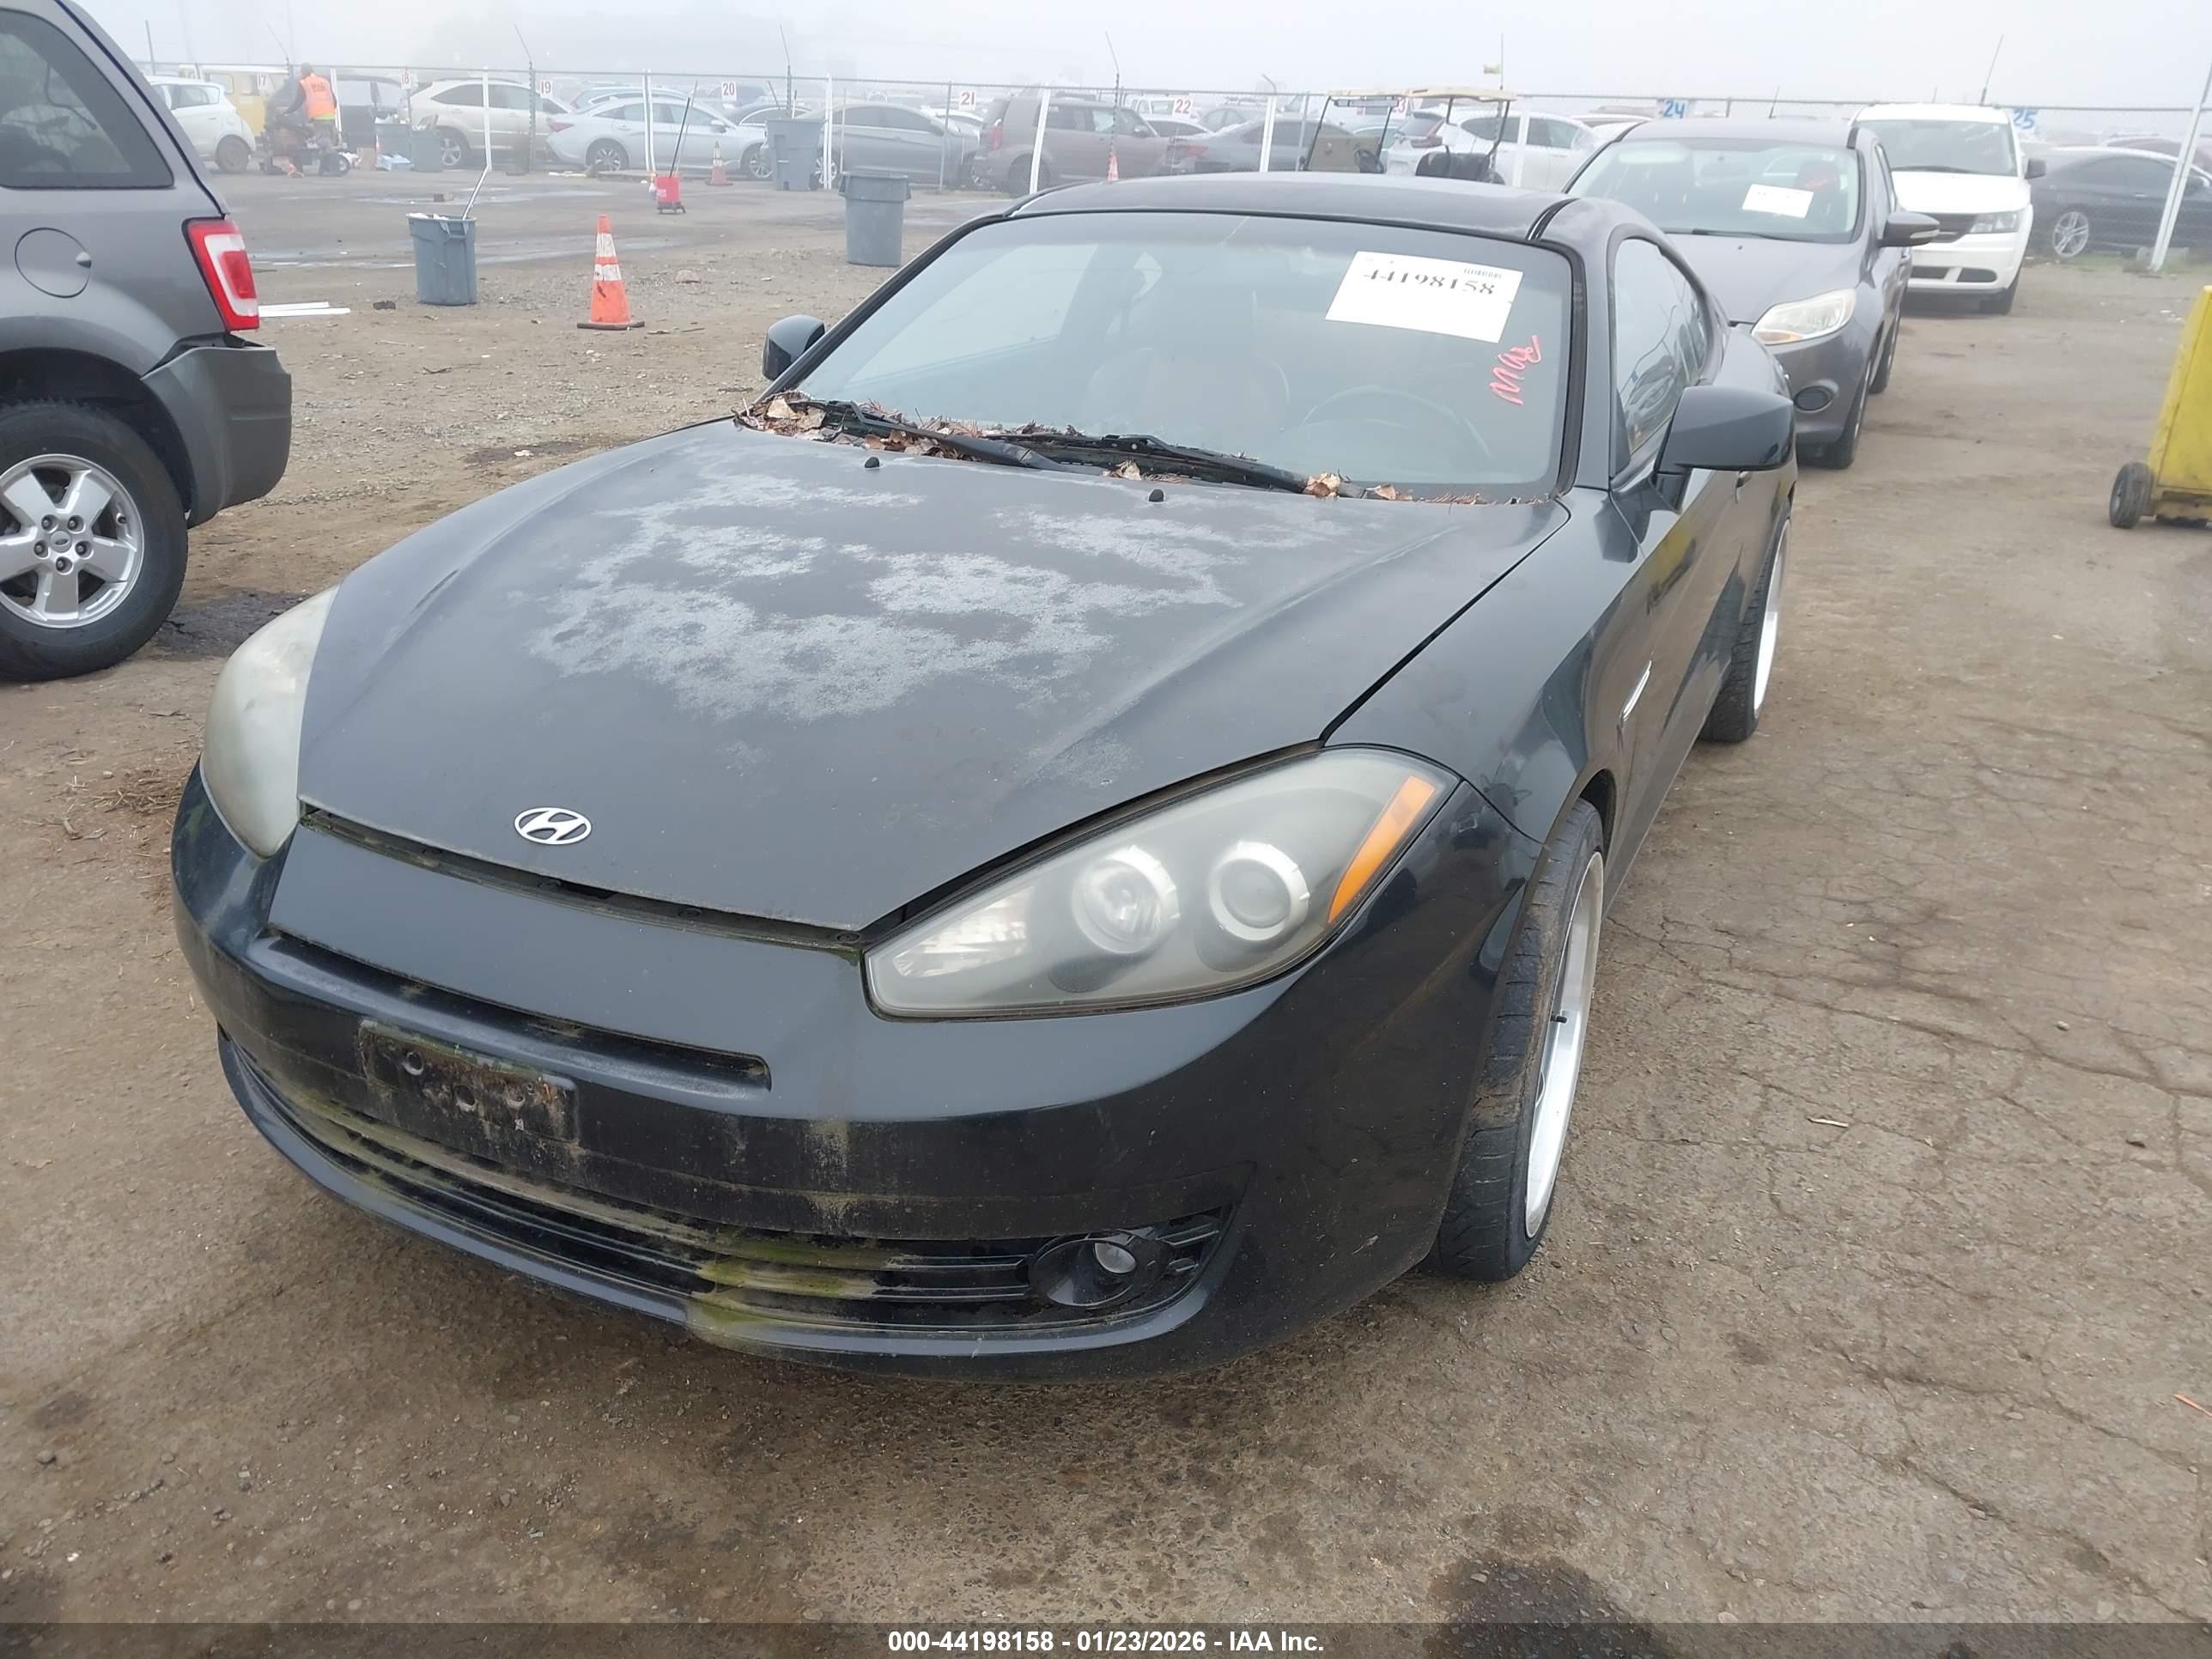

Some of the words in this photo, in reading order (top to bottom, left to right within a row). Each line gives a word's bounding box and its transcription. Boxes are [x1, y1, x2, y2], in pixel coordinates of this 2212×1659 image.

[258, 76, 266, 87] 17
[541, 82, 551, 94] 19
[723, 82, 735, 95] 20
[961, 92, 975, 105] 21
[1175, 99, 1191, 113] 22
[1663, 99, 1685, 118] 24
[2013, 109, 2038, 130] 25
[1364, 269, 1495, 295] 44198158
